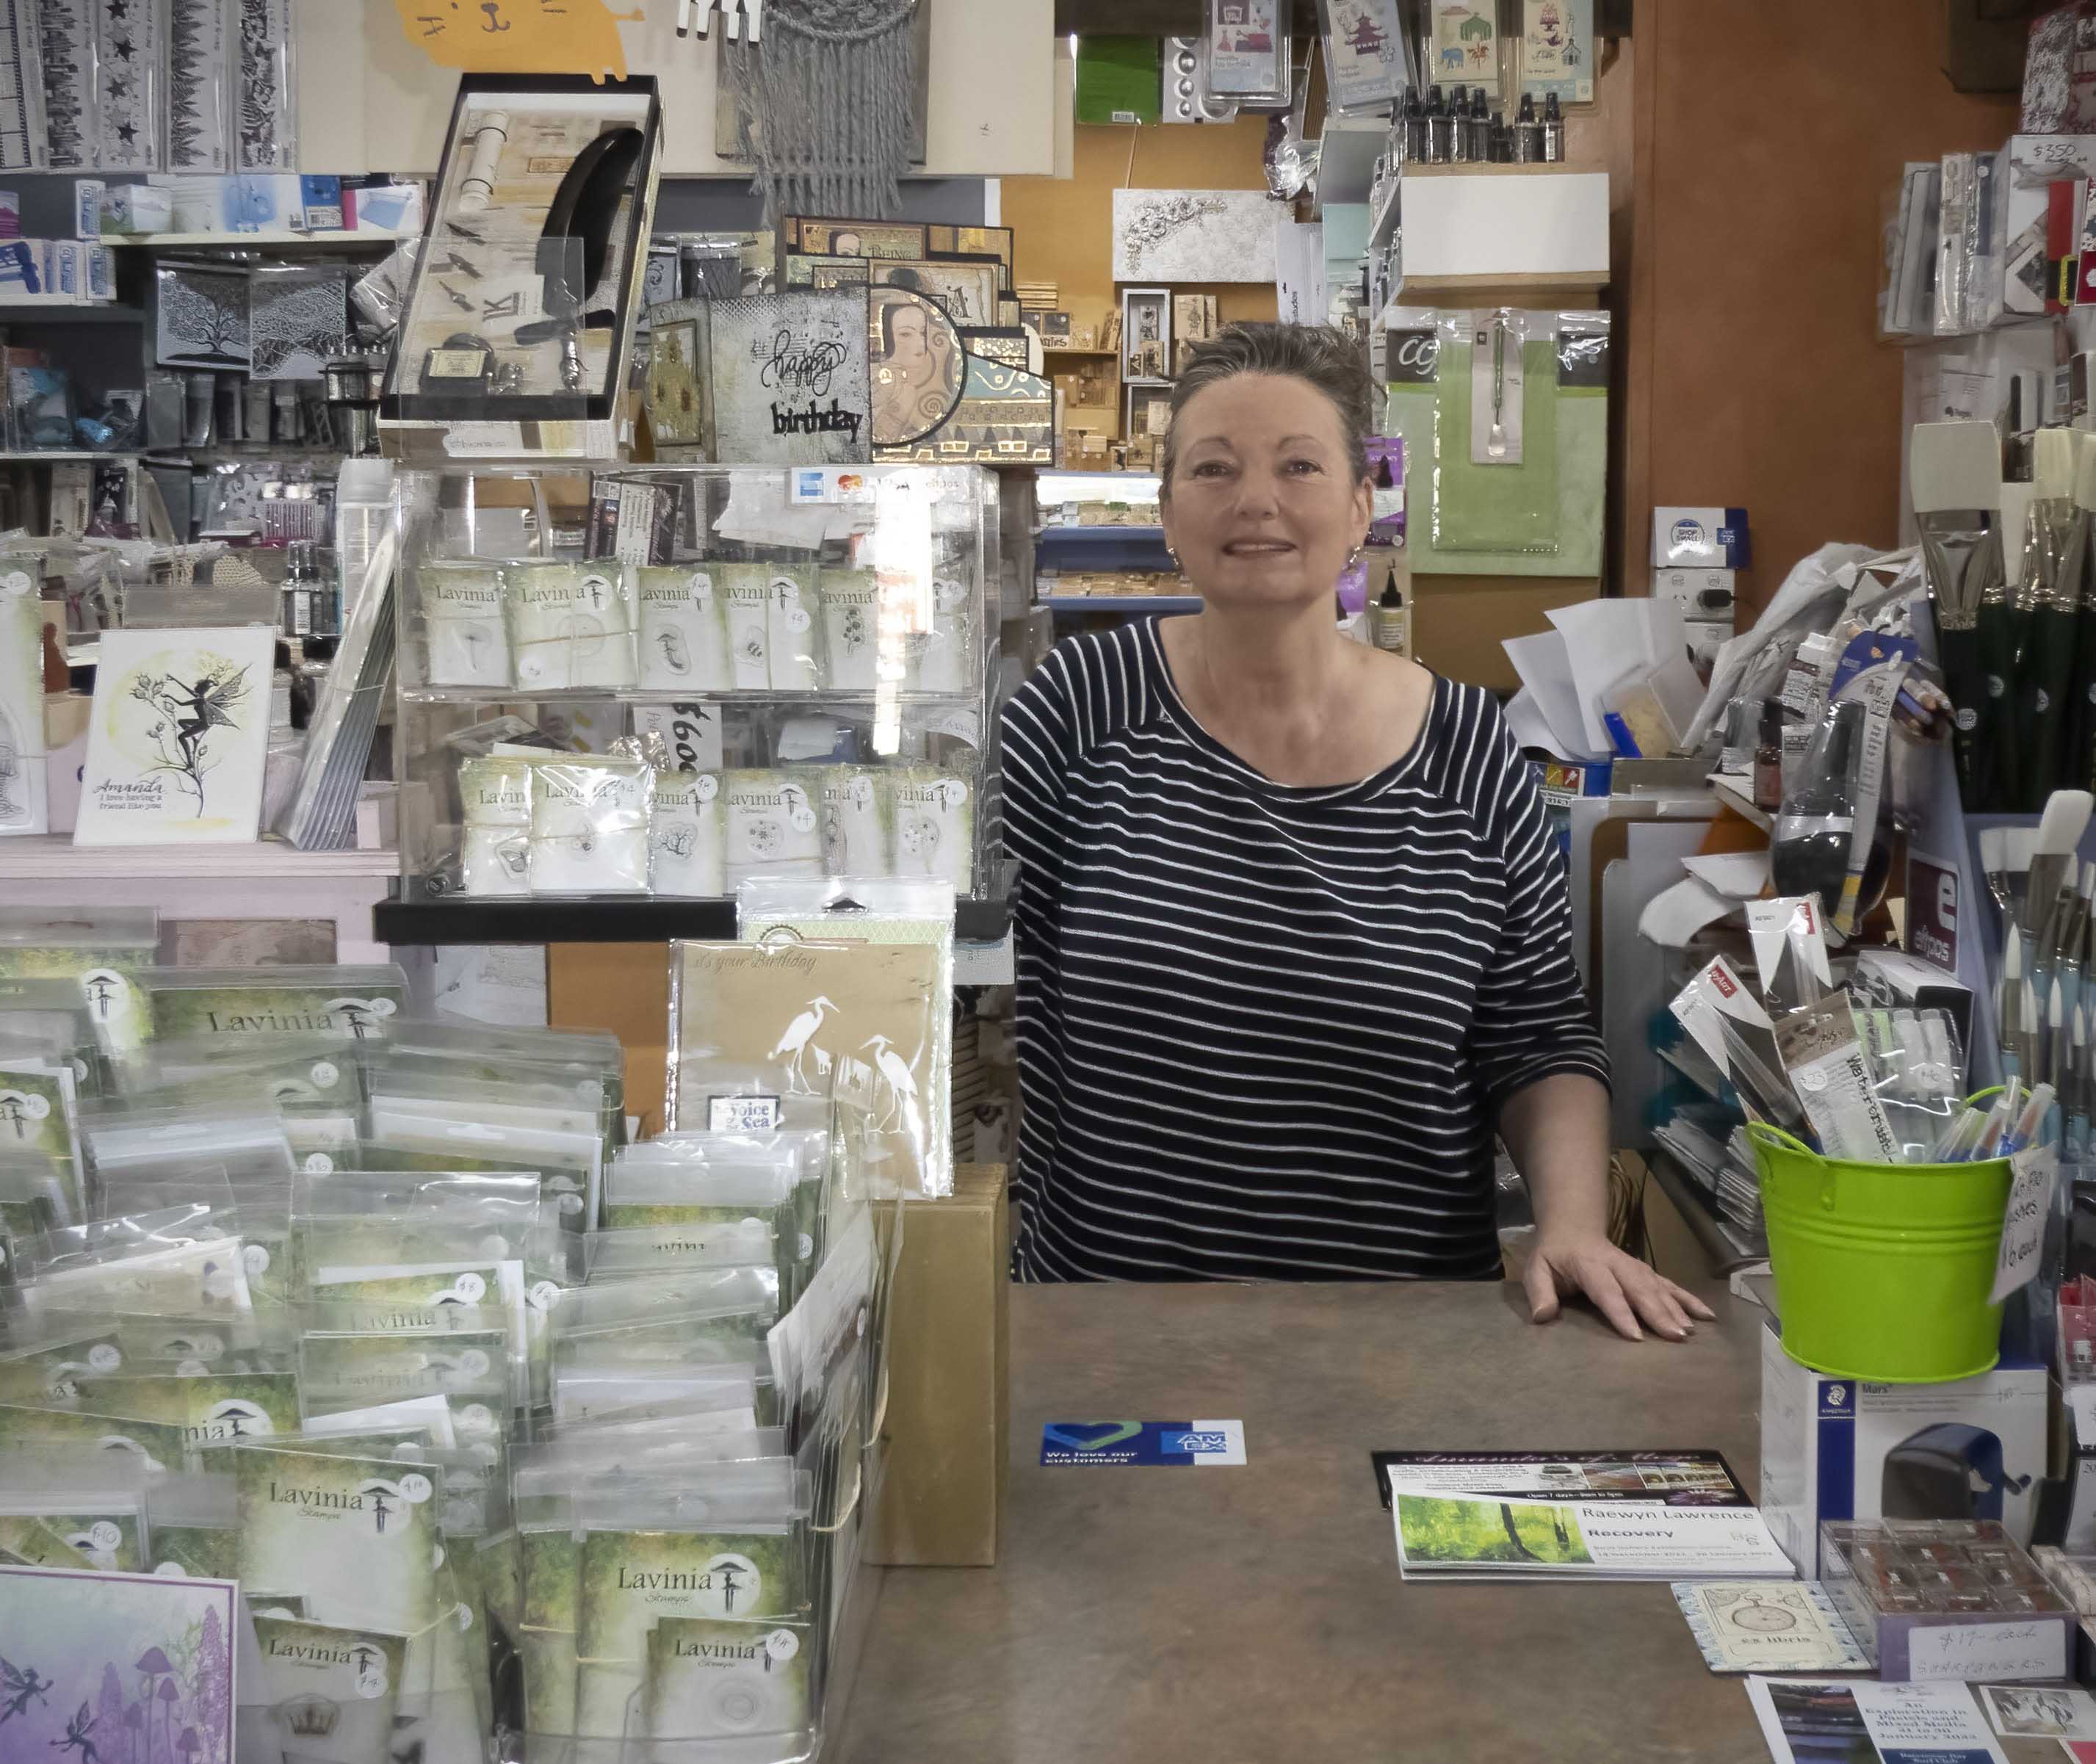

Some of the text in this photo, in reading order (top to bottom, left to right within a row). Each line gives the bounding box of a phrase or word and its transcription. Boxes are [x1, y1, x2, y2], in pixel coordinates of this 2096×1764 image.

[762, 330, 847, 397] happy
[770, 399, 863, 444] birthday
[93, 776, 165, 793] Amanda
[206, 1010, 333, 1033] Lavinia
[270, 1481, 364, 1511] Lavinia
[1583, 1506, 1754, 1520] Raewyn Lawrence
[1588, 1528, 1674, 1539] Recovery
[618, 1566, 712, 1590] Lavinia
[675, 1638, 756, 1660] Lavinia
[1767, 1635, 1812, 1644] libris
[270, 1638, 352, 1665] Lavinia
